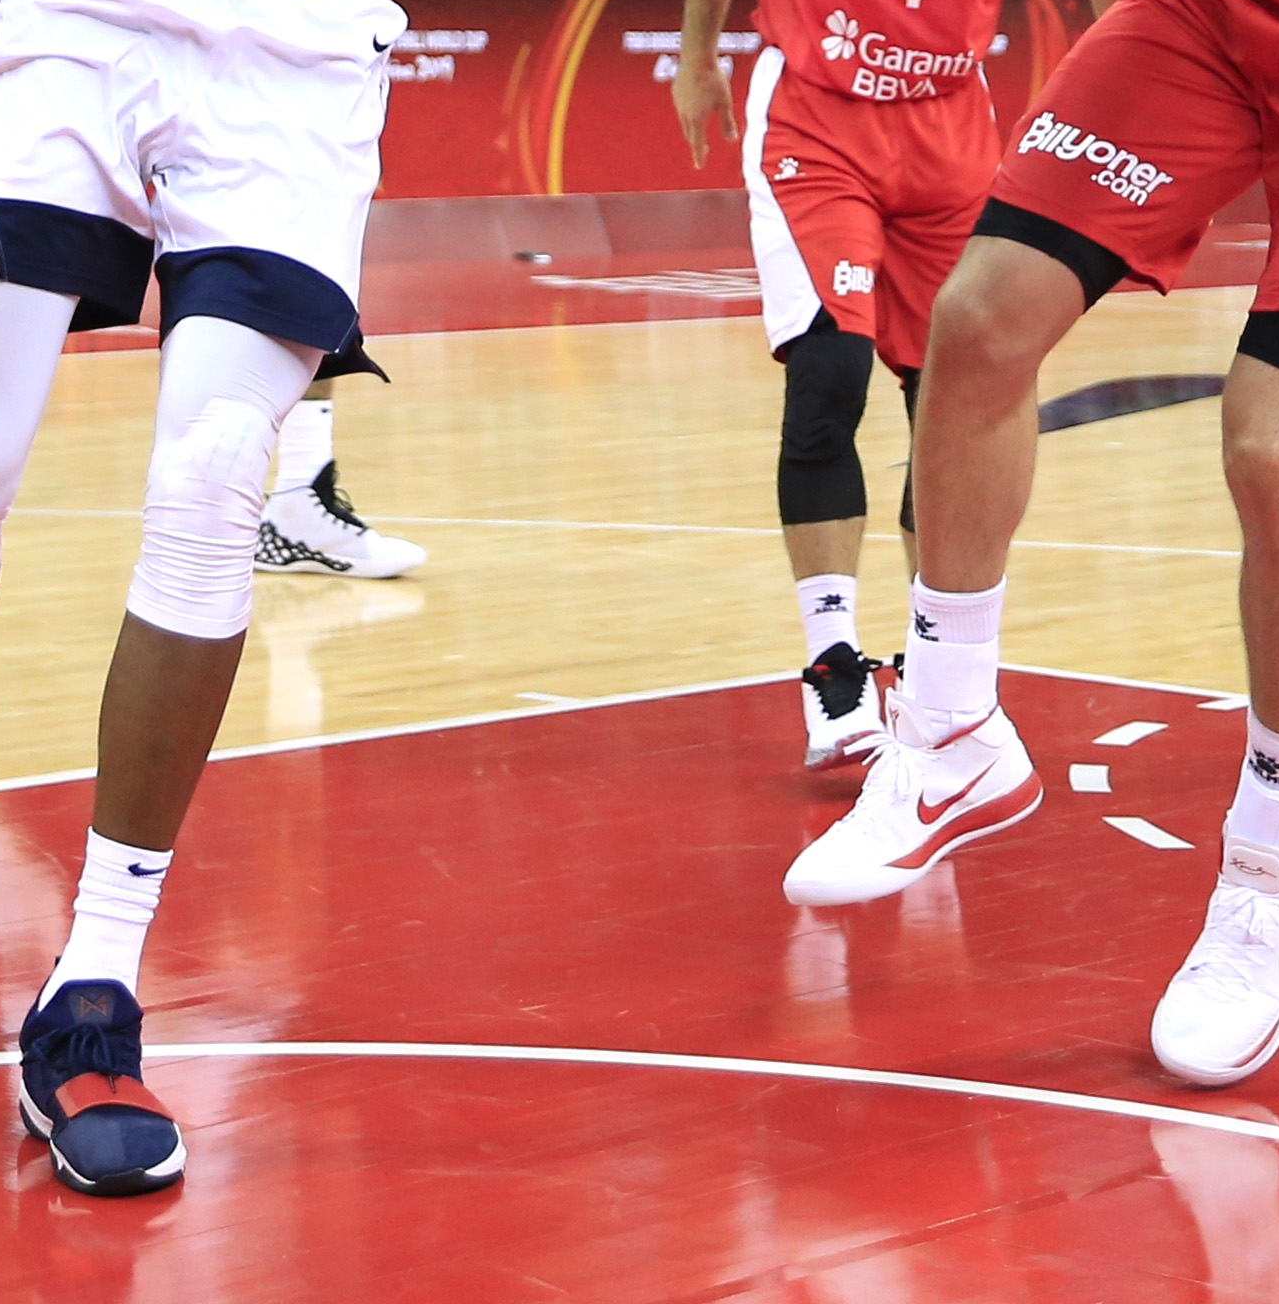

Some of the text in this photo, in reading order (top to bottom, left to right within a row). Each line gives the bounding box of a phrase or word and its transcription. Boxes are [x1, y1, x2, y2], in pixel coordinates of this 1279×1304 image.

[858, 32, 975, 77] Garanti
[851, 67, 937, 101] BBVA
[1018, 112, 1173, 193] Bilyoner
[1090, 170, 1149, 206] .com
